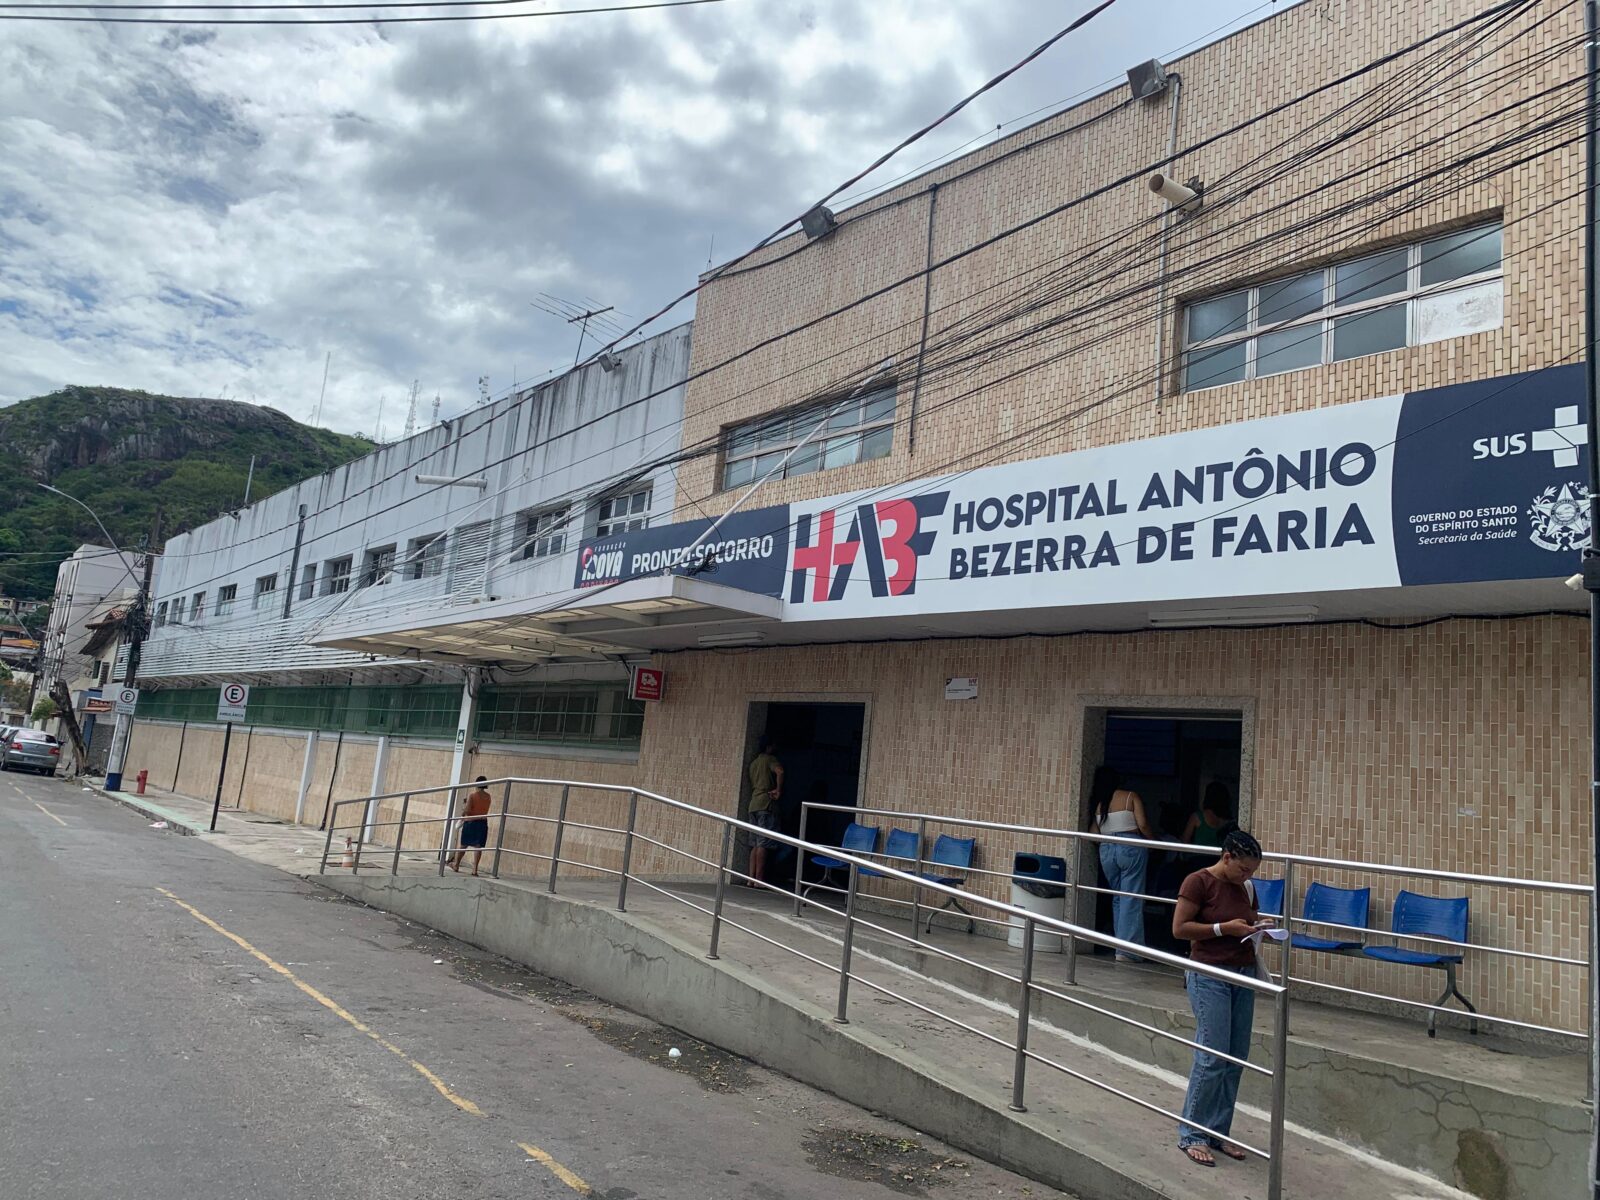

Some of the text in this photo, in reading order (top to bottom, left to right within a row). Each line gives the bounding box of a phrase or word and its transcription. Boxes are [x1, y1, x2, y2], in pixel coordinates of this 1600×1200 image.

[1472, 432, 1527, 460] SUS
[952, 442, 1377, 535] HOSPITAL ANTÔNIO
[1408, 505, 1518, 524] GOVERNO DO ESTADO
[1415, 516, 1518, 534] DO ESPÍRITO SANTO
[790, 491, 950, 604] HABF
[949, 502, 1376, 580] BEZERRA DE FARIA
[1417, 528, 1518, 545] Secretaria da Saúde
